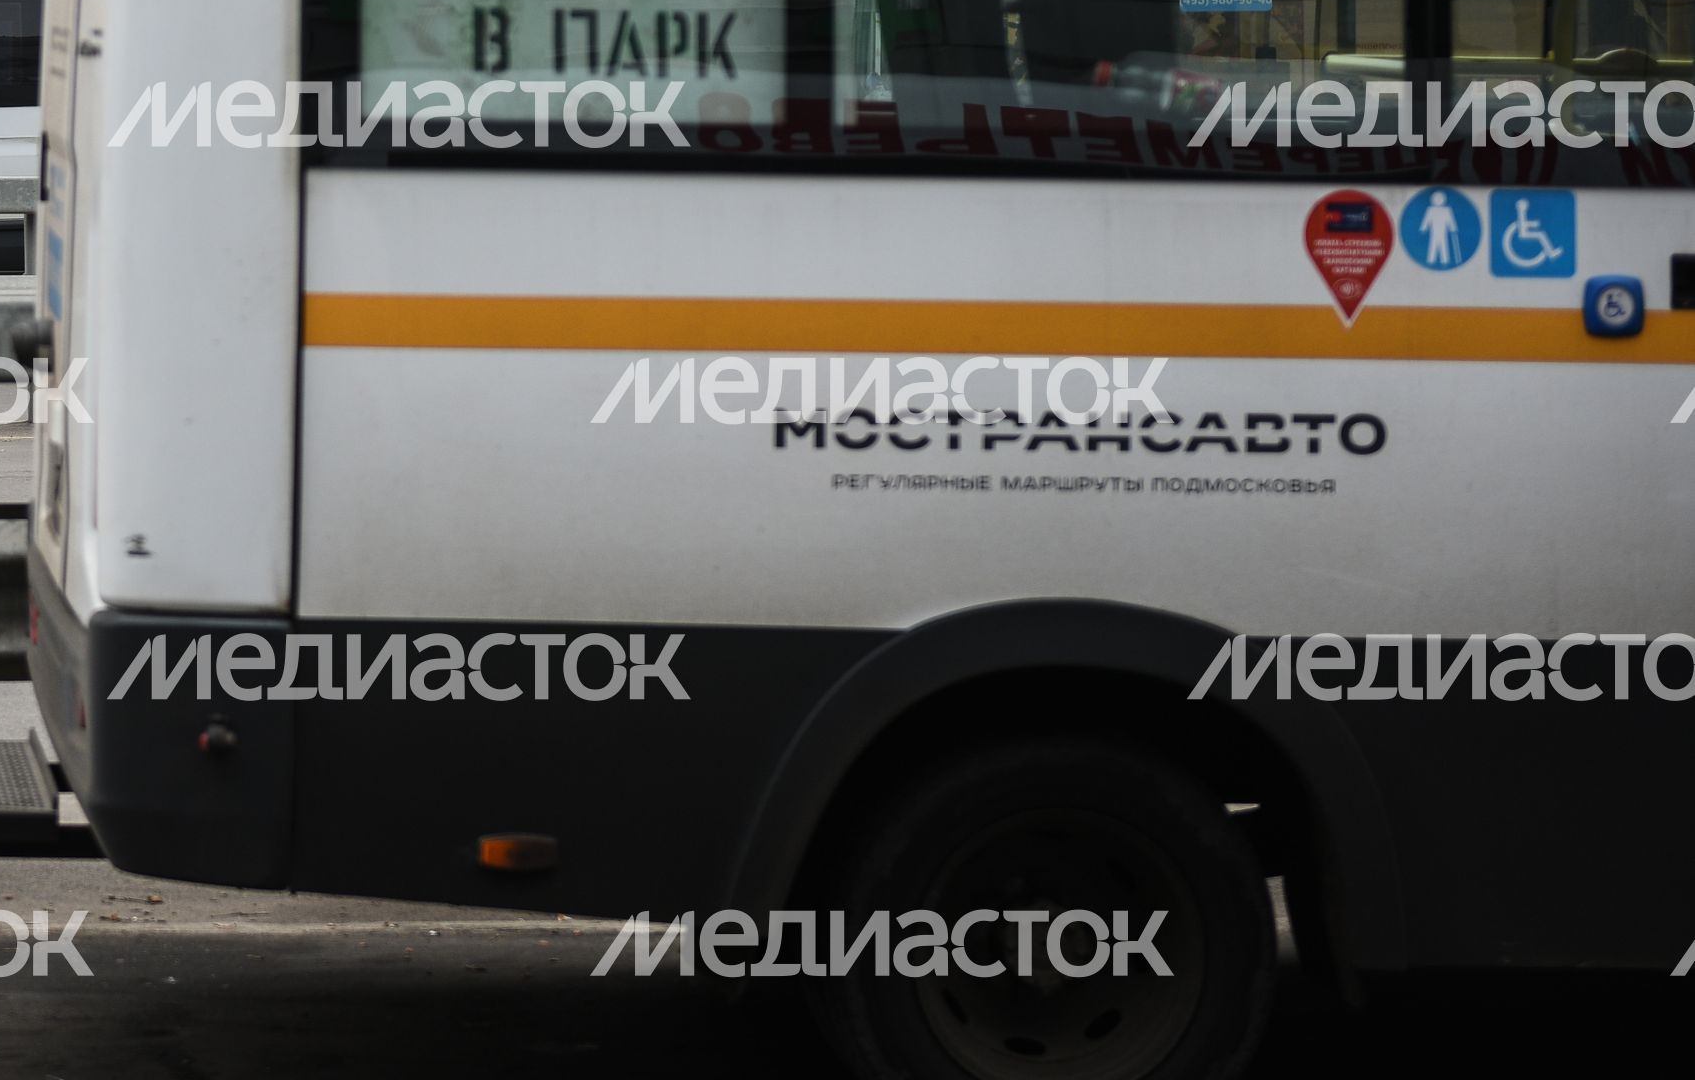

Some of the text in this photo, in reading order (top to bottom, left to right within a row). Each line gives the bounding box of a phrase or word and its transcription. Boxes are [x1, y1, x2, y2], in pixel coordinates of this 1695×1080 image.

[472, 5, 738, 79] В ПАРК
[772, 407, 1388, 456] МОСТРАНСАВТО
[831, 473, 1338, 495] РЕГУЛЯРНЫЕ МАРШРУТЫ ПОДМОСКОВЬЯ
